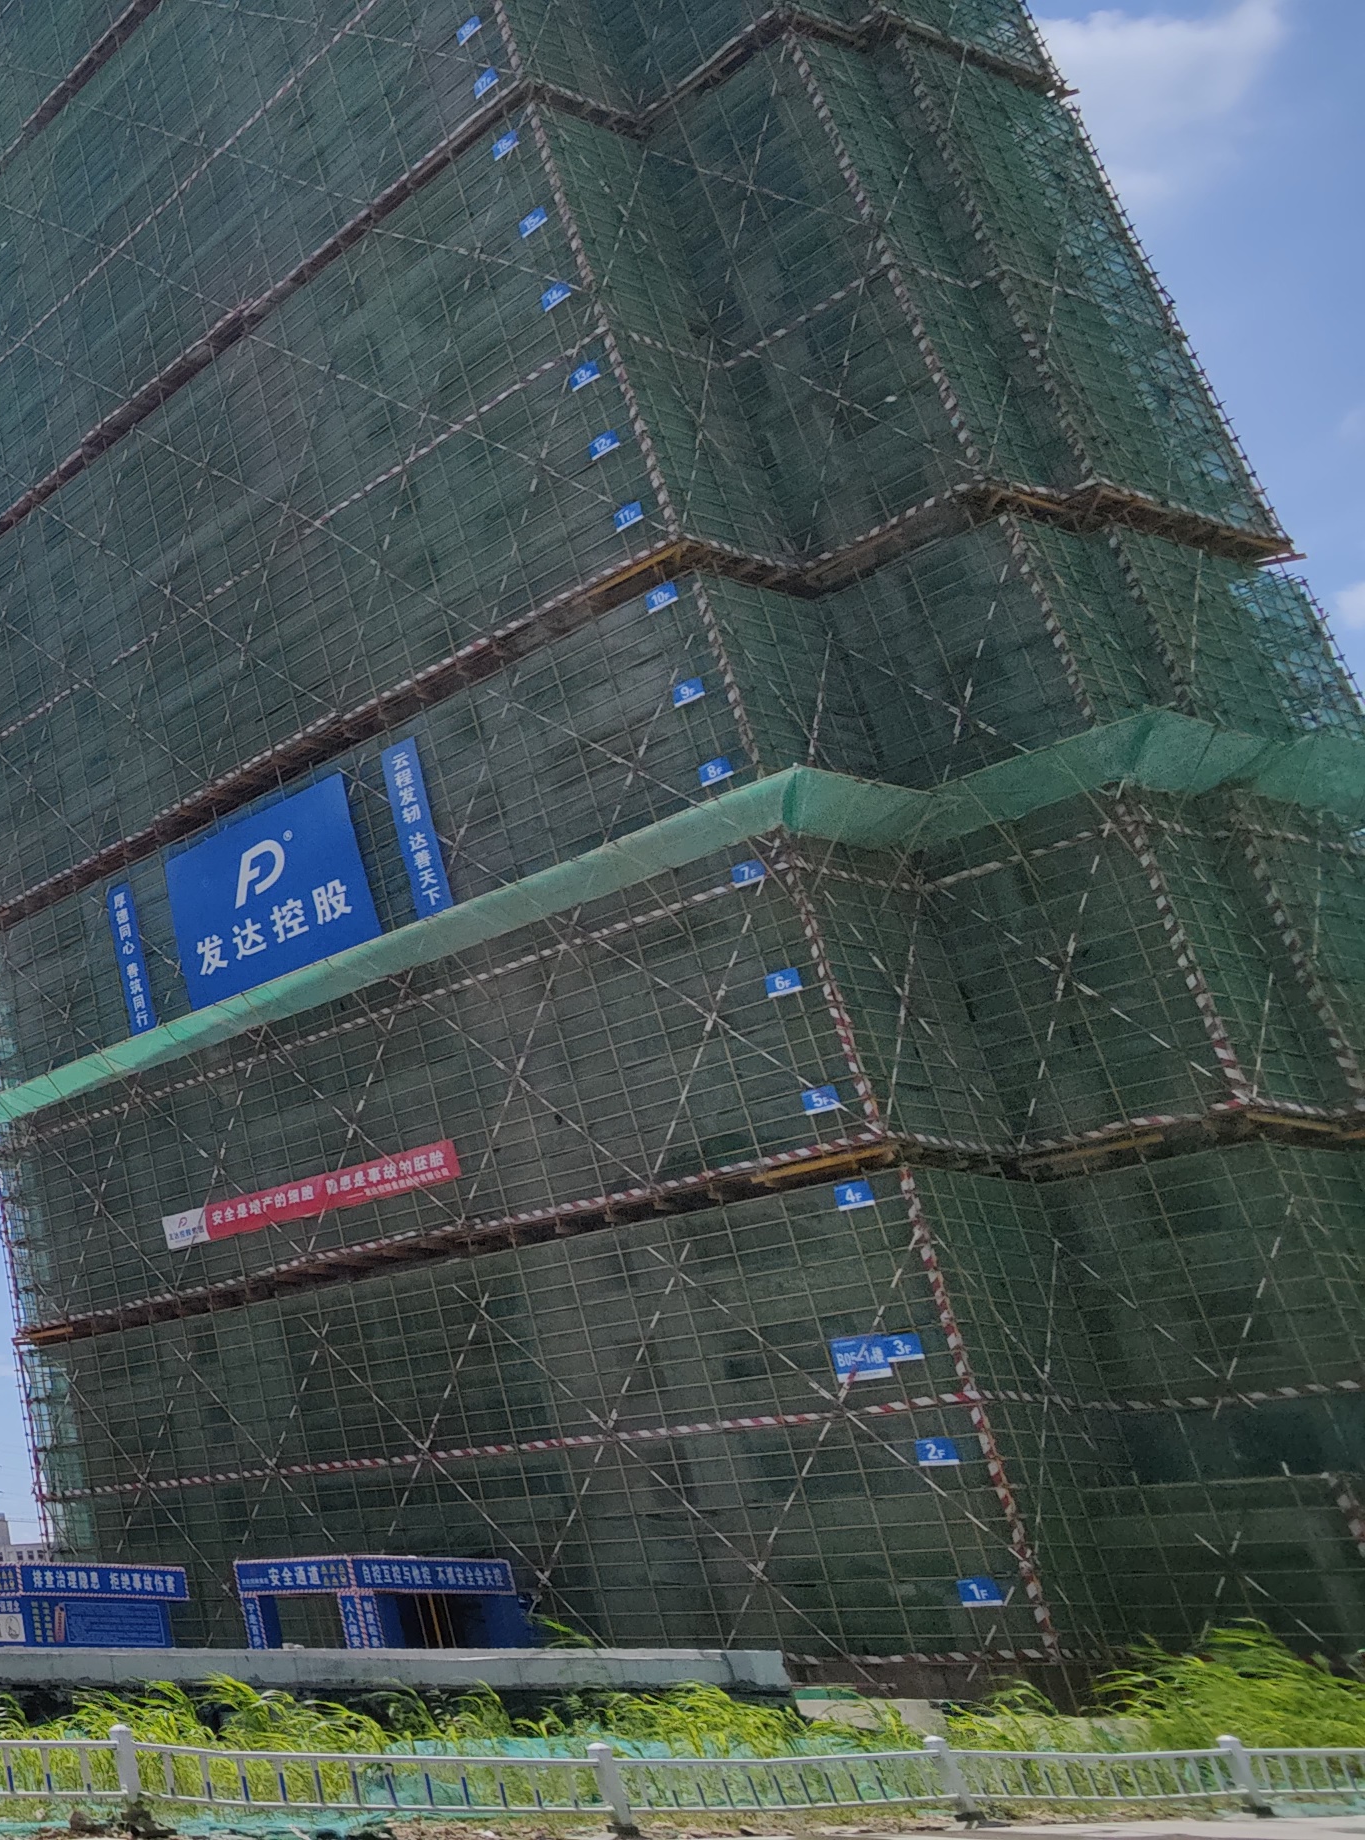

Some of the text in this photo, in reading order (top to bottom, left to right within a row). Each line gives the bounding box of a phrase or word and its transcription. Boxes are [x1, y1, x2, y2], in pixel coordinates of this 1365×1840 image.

[524, 213, 541, 229] 15F
[573, 368, 591, 384] 13F
[593, 437, 612, 453] 12F
[617, 508, 636, 525] 11F
[650, 590, 670, 607] 10F
[679, 685, 695, 700] 9F
[706, 763, 723, 779] 8F
[391, 752, 442, 907] 云程发轫 达善天下
[740, 865, 757, 881] 7F
[195, 879, 353, 977] 发达控股
[113, 892, 149, 1028] 厚德同心 善筑同行
[774, 975, 792, 991] 6F
[812, 1092, 829, 1108] 5F
[211, 1150, 445, 1226] 安全是增产的细胞 隐患是事故的胚胎
[845, 1187, 862, 1203] 4F
[893, 1339, 912, 1355] 3F
[925, 1443, 946, 1460] 2F
[32, 1569, 176, 1594] 排查治理隐患 拒绝事故伤害
[269, 1565, 321, 1587] 安全通道
[969, 1583, 989, 1600] 1F
